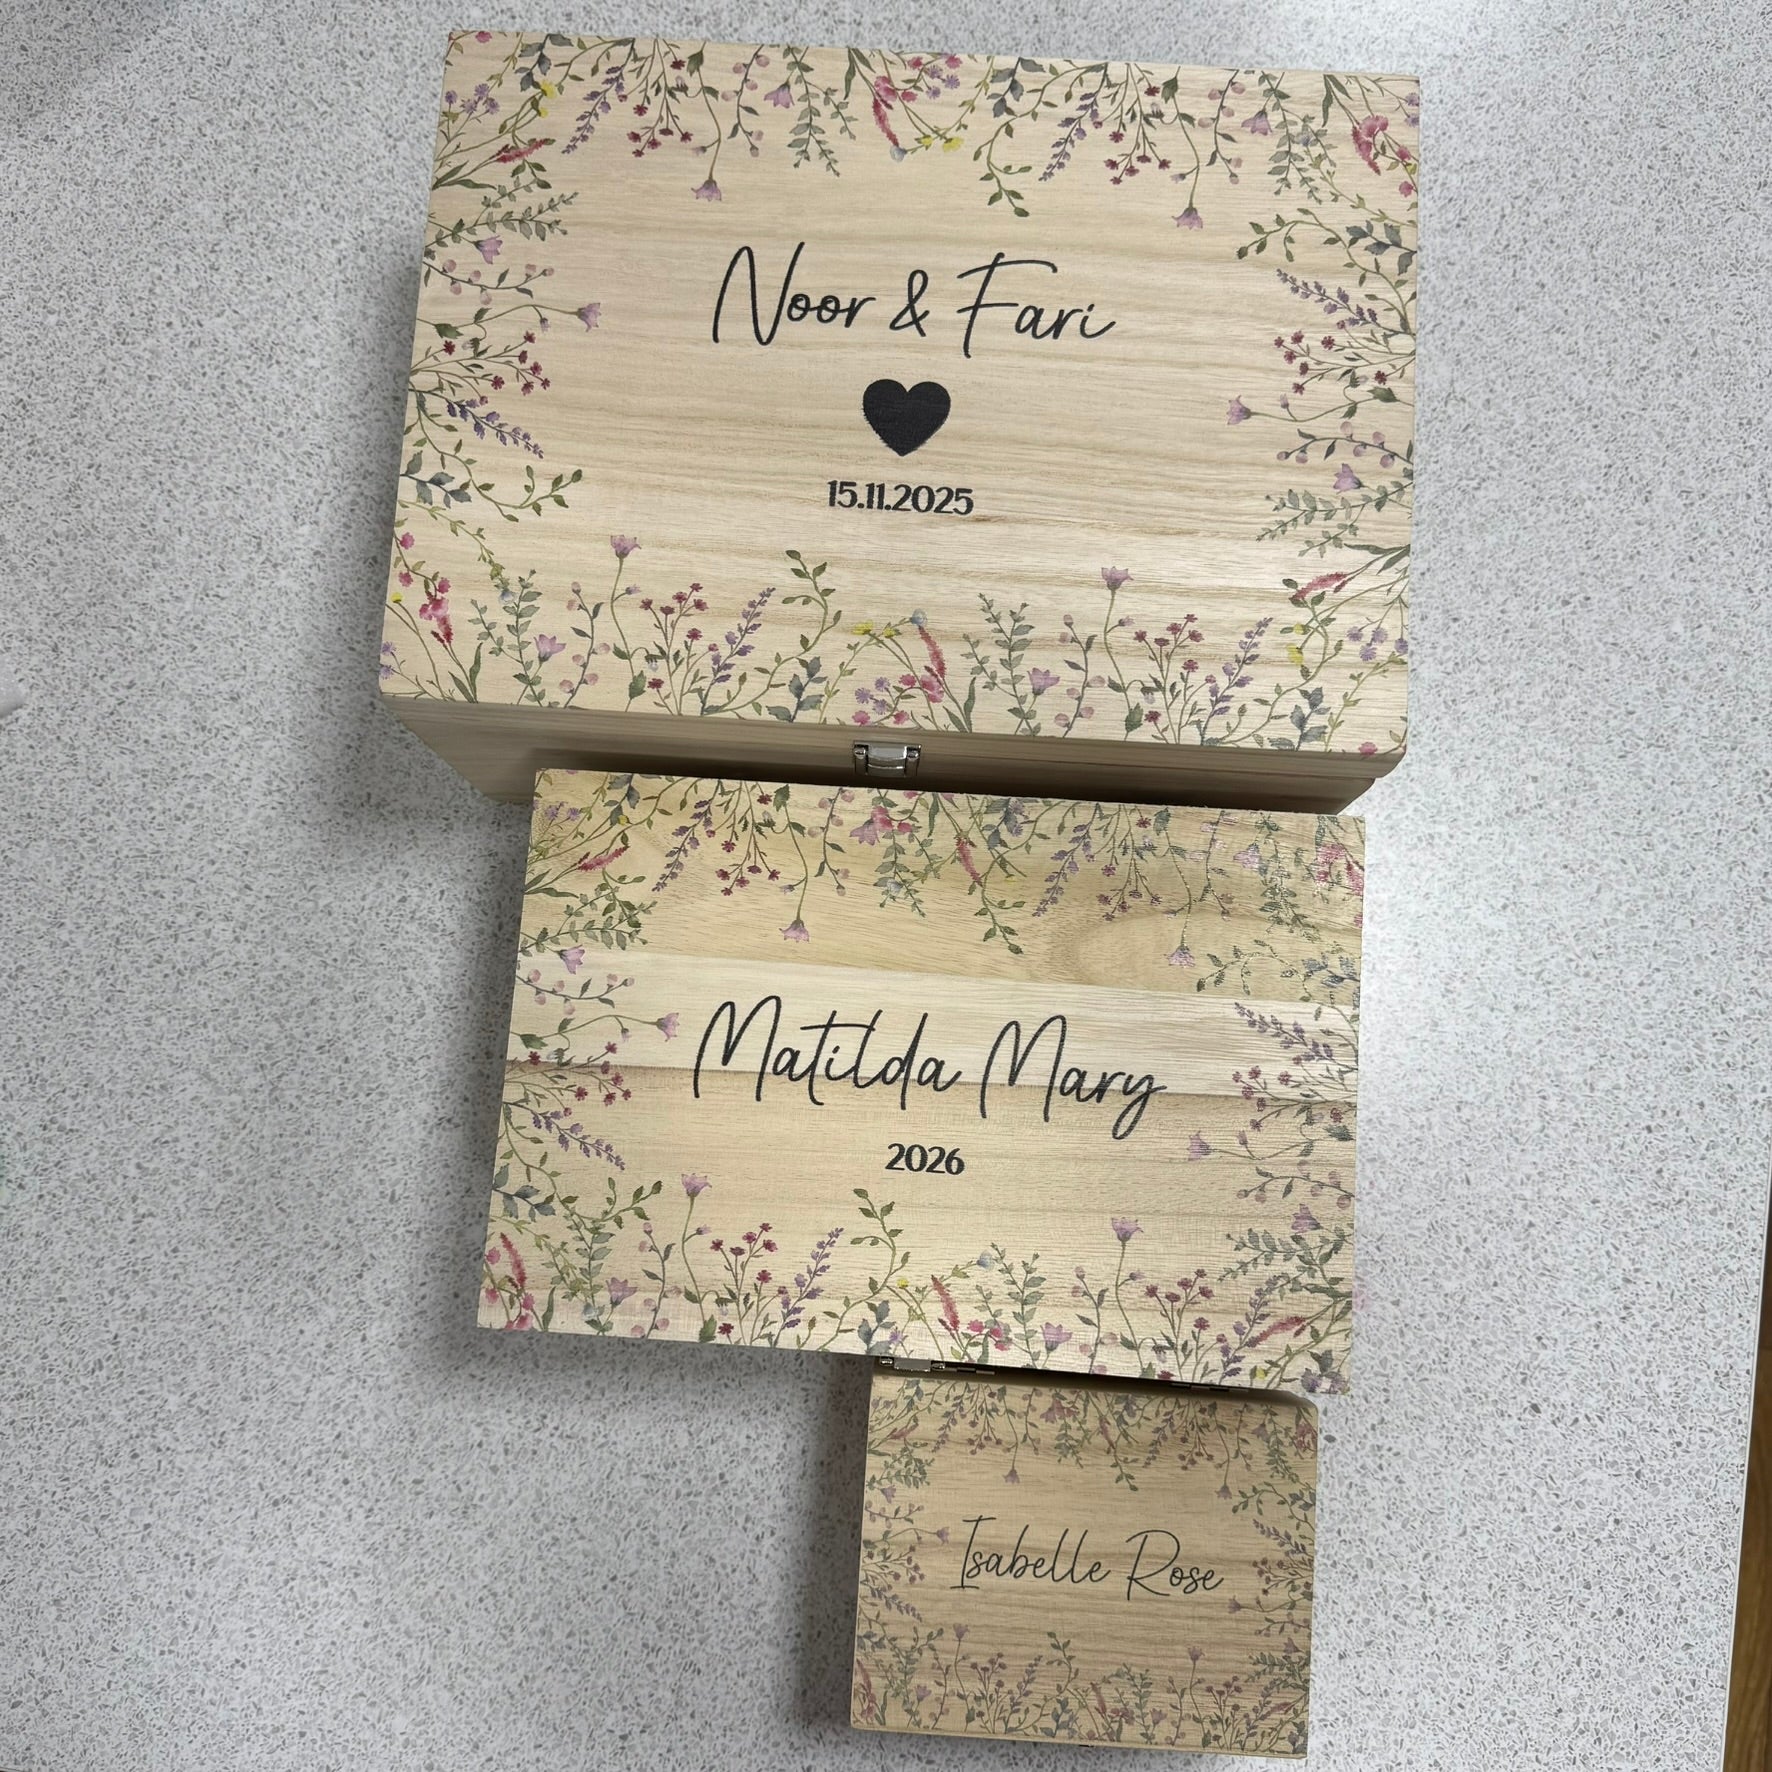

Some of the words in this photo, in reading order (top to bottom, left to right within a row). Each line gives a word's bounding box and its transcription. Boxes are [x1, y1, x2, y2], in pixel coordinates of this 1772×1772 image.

[712, 241, 876, 346] Noor
[889, 269, 931, 337] &
[956, 252, 1116, 359] Fari
[827, 480, 975, 516] 15.11.2025
[693, 995, 962, 1111] Matilda
[979, 1014, 1168, 1140] Mary
[885, 1143, 965, 1175] 2026
[949, 1514, 1112, 1590] Isabelle
[1125, 1529, 1225, 1601] Rose
